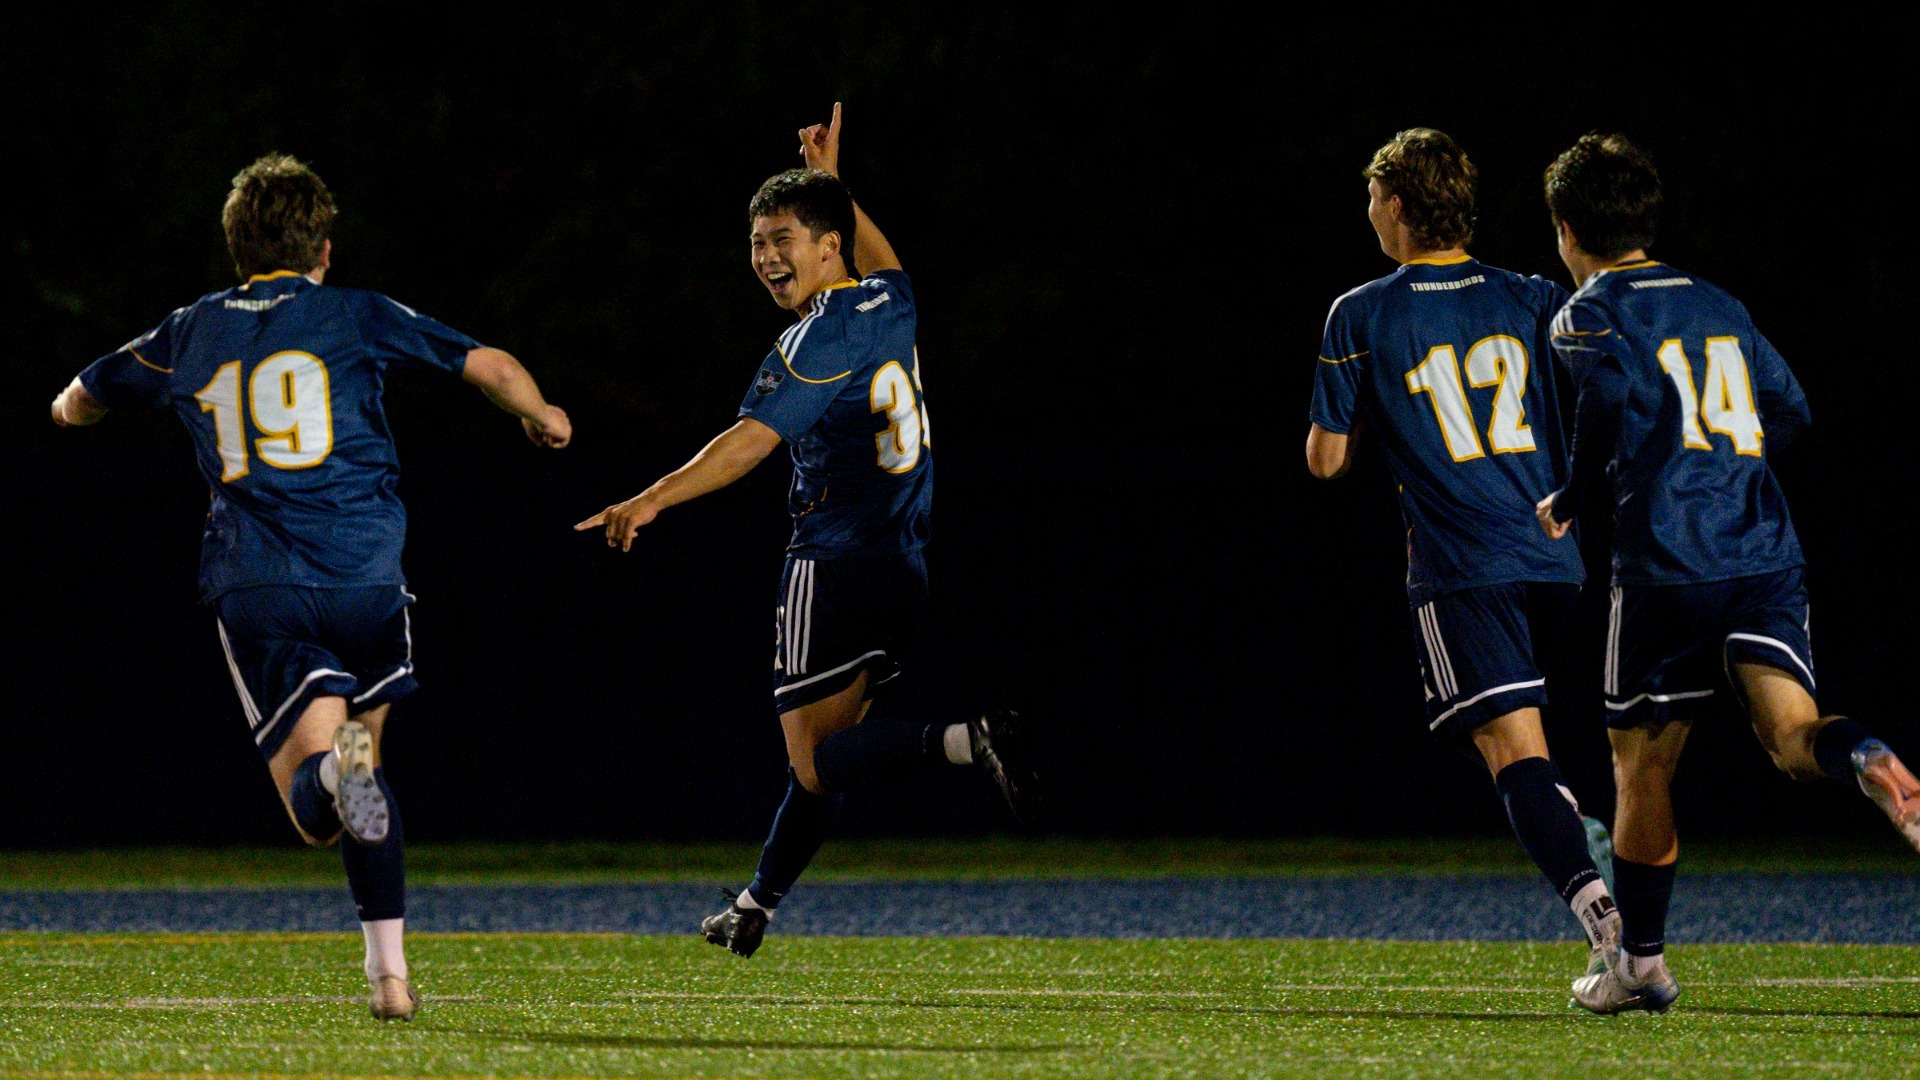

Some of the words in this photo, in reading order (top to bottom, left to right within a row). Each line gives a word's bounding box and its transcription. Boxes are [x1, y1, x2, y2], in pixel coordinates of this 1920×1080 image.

[1409, 274, 1485, 291] THUNDERBIRDS
[193, 349, 334, 484] 19
[869, 344, 931, 474] 3
[1404, 333, 1537, 463] 12
[1656, 335, 1764, 457] 14
